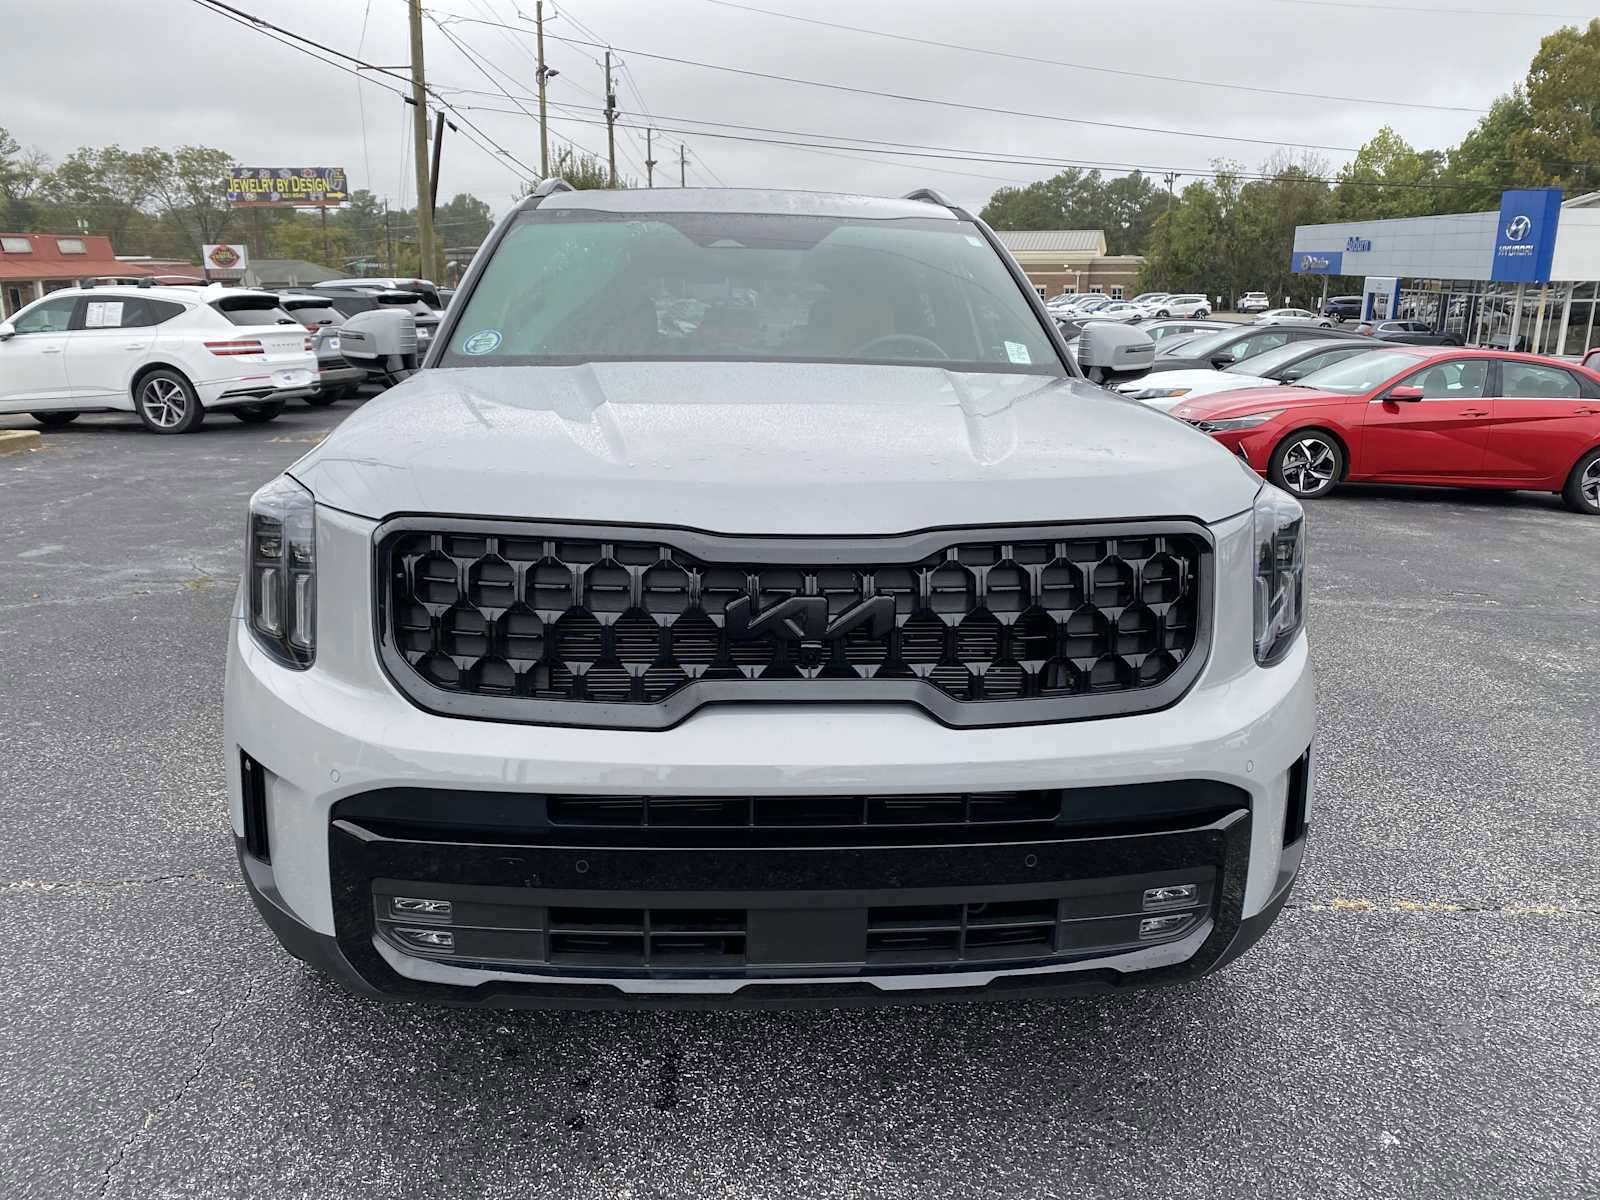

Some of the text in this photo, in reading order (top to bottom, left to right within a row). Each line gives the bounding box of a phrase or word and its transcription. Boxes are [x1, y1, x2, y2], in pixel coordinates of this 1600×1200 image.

[227, 175, 330, 192] JEWELRY BY DESIGN
[1498, 245, 1533, 256] HYUNDAI
